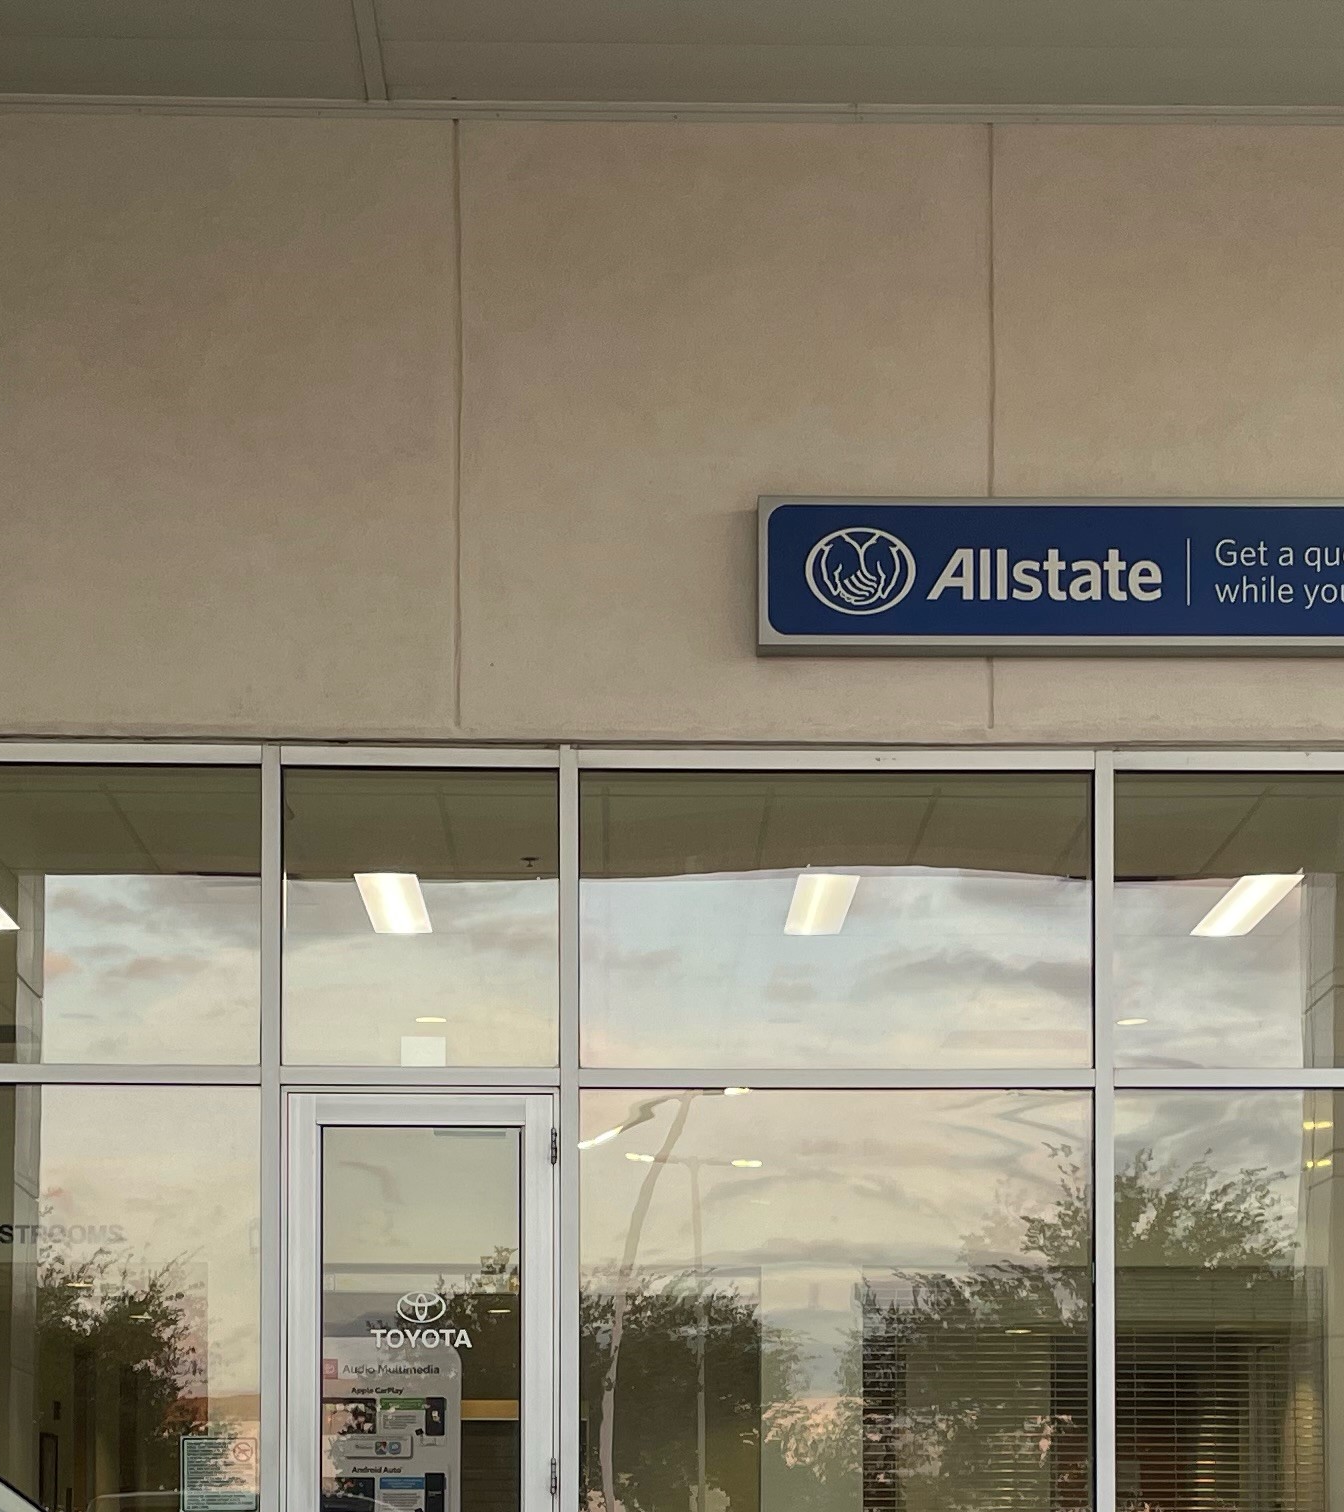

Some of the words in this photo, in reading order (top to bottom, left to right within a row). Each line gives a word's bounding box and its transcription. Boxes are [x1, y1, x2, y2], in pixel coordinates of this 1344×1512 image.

[1215, 538, 1268, 567] Get
[1278, 546, 1294, 567] a
[926, 548, 1163, 602] Allstate
[1214, 575, 1294, 604] while
[370, 1328, 473, 1349] TOYOTA
[342, 1364, 375, 1375] Audio
[377, 1364, 440, 1375] Multimedia
[351, 1387, 374, 1395] Apple
[374, 1387, 404, 1395] CarPlay
[351, 1465, 382, 1474] Android
[382, 1465, 402, 1474] Auto
